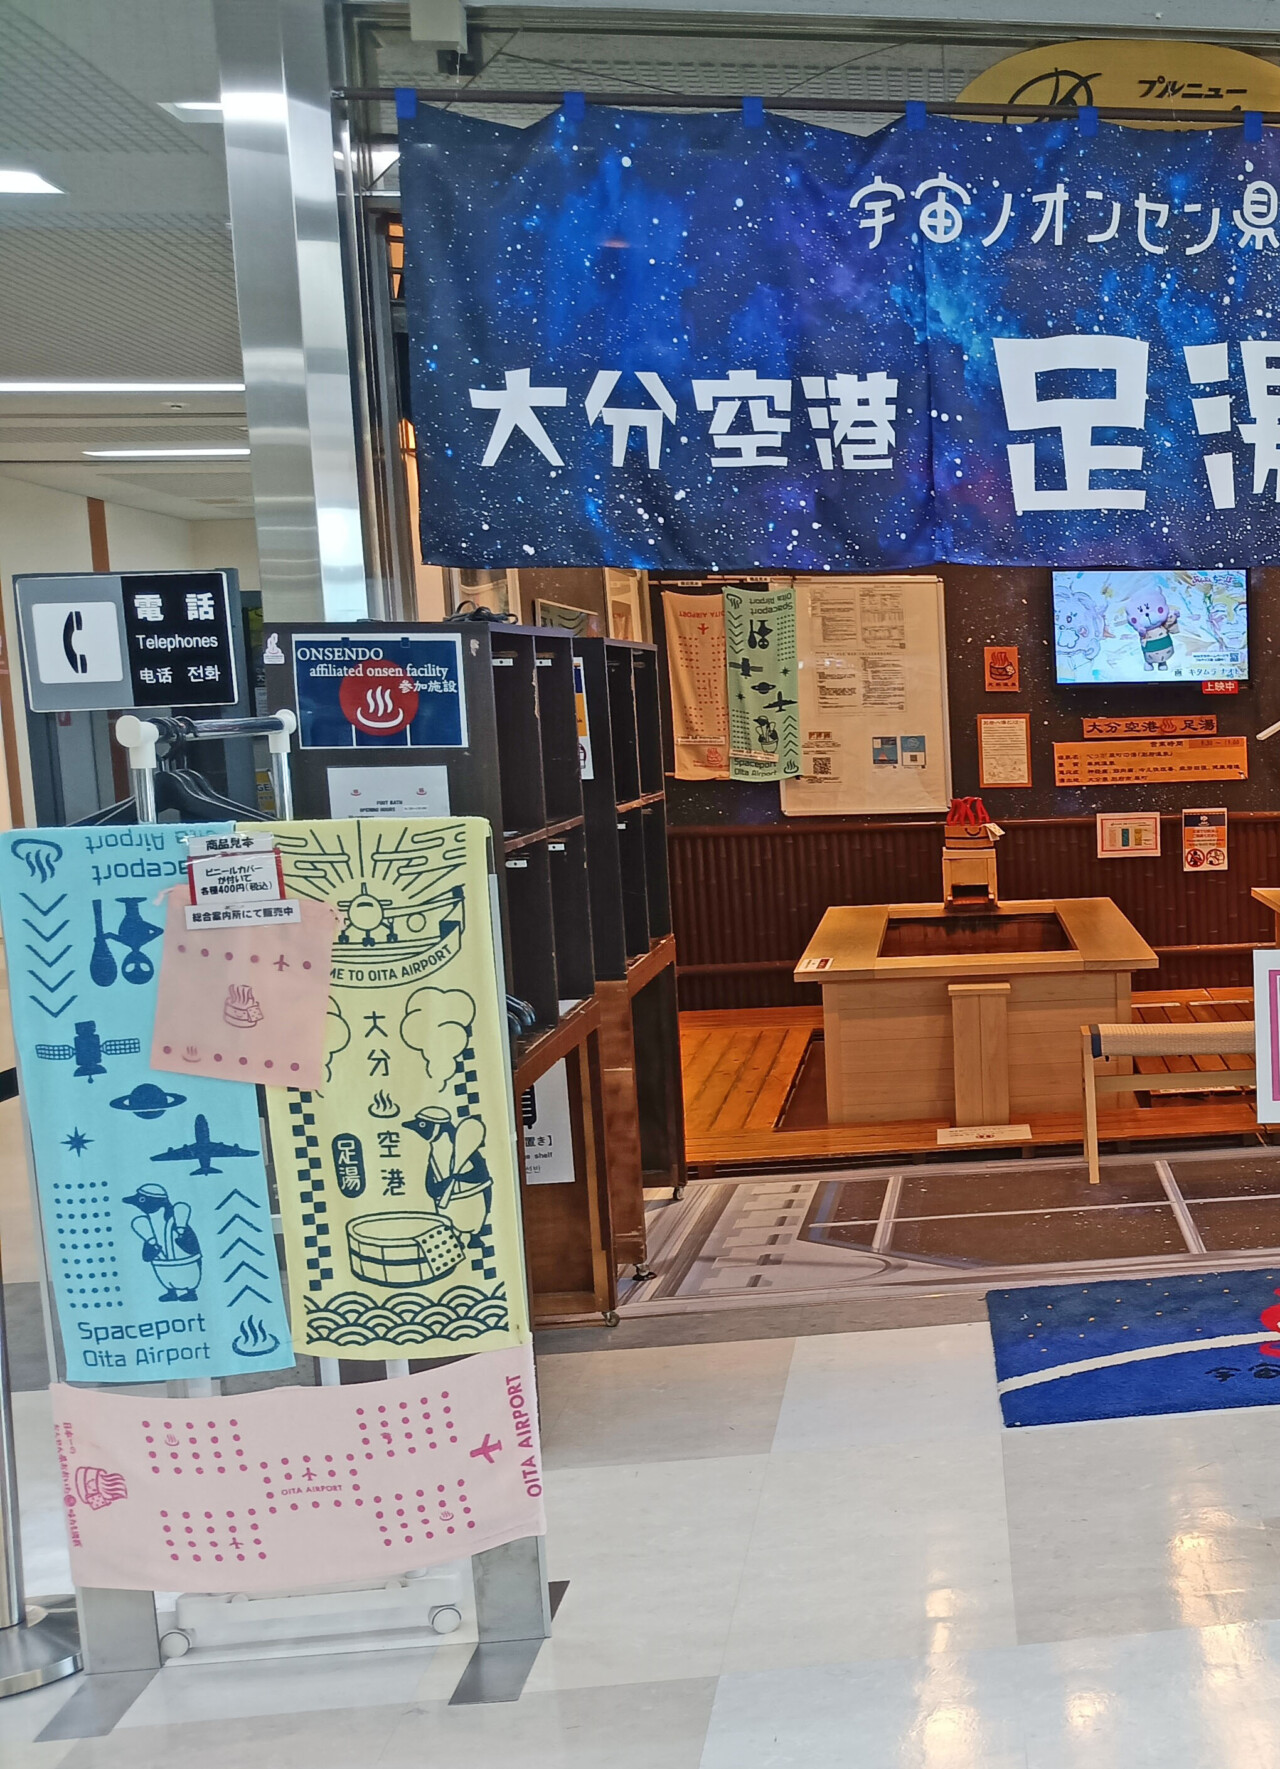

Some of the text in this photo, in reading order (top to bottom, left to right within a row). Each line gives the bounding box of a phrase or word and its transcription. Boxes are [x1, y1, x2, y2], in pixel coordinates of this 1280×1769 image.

[1138, 76, 1248, 99] プルニュー
[468, 367, 899, 471] 大分空港
[133, 592, 215, 622] 電話
[750, 602, 794, 616] Spaceport
[135, 634, 219, 652] Telephones
[297, 647, 384, 661] ONSENDO
[139, 665, 221, 684] 电话 전화
[309, 663, 449, 679] affiliated onsen facility
[398, 679, 458, 694] 参加施設
[1204, 681, 1236, 692] 上映中
[1086, 719, 1216, 734] 大分空港 足湯
[86, 830, 165, 855] Airport
[206, 836, 255, 851] 商品見本
[92, 857, 188, 886] aceport
[205, 865, 264, 877] ビニールカバー
[217, 874, 252, 885] が付いて
[192, 906, 294, 923] 総合案内所にて販売中
[349, 969, 364, 982] TO
[368, 968, 398, 981] OITA
[401, 944, 452, 979] AIRPORT
[363, 1010, 407, 1197] 大分 空港
[336, 1138, 362, 1194] 足湯
[77, 1313, 206, 1347] Spaceport
[82, 1342, 211, 1368] Oita Airport
[505, 1374, 543, 1498] OITA AIRPORT
[281, 1484, 342, 1496] OITA AIRPORT
